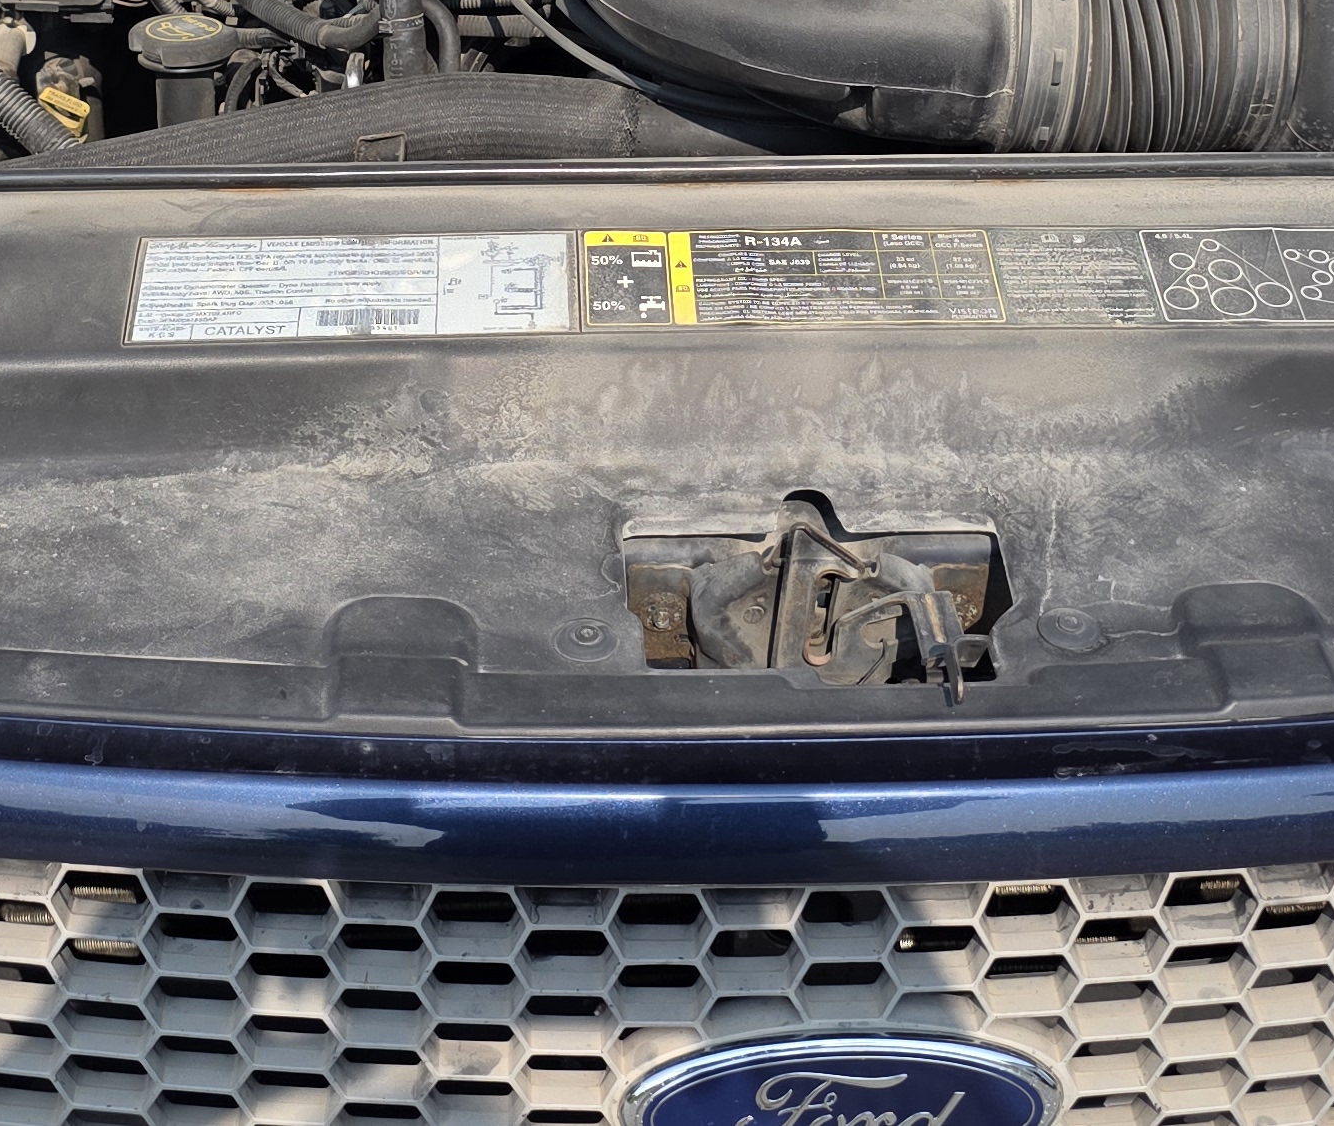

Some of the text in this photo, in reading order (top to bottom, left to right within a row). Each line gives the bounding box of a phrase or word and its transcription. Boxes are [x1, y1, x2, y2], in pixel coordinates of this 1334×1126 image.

[744, 235, 803, 247] R-134A
[882, 233, 923, 241] F Series
[591, 255, 624, 265] 50%
[592, 301, 626, 311] 50%
[948, 307, 997, 315] Visteon
[205, 325, 287, 337] CATALYST
